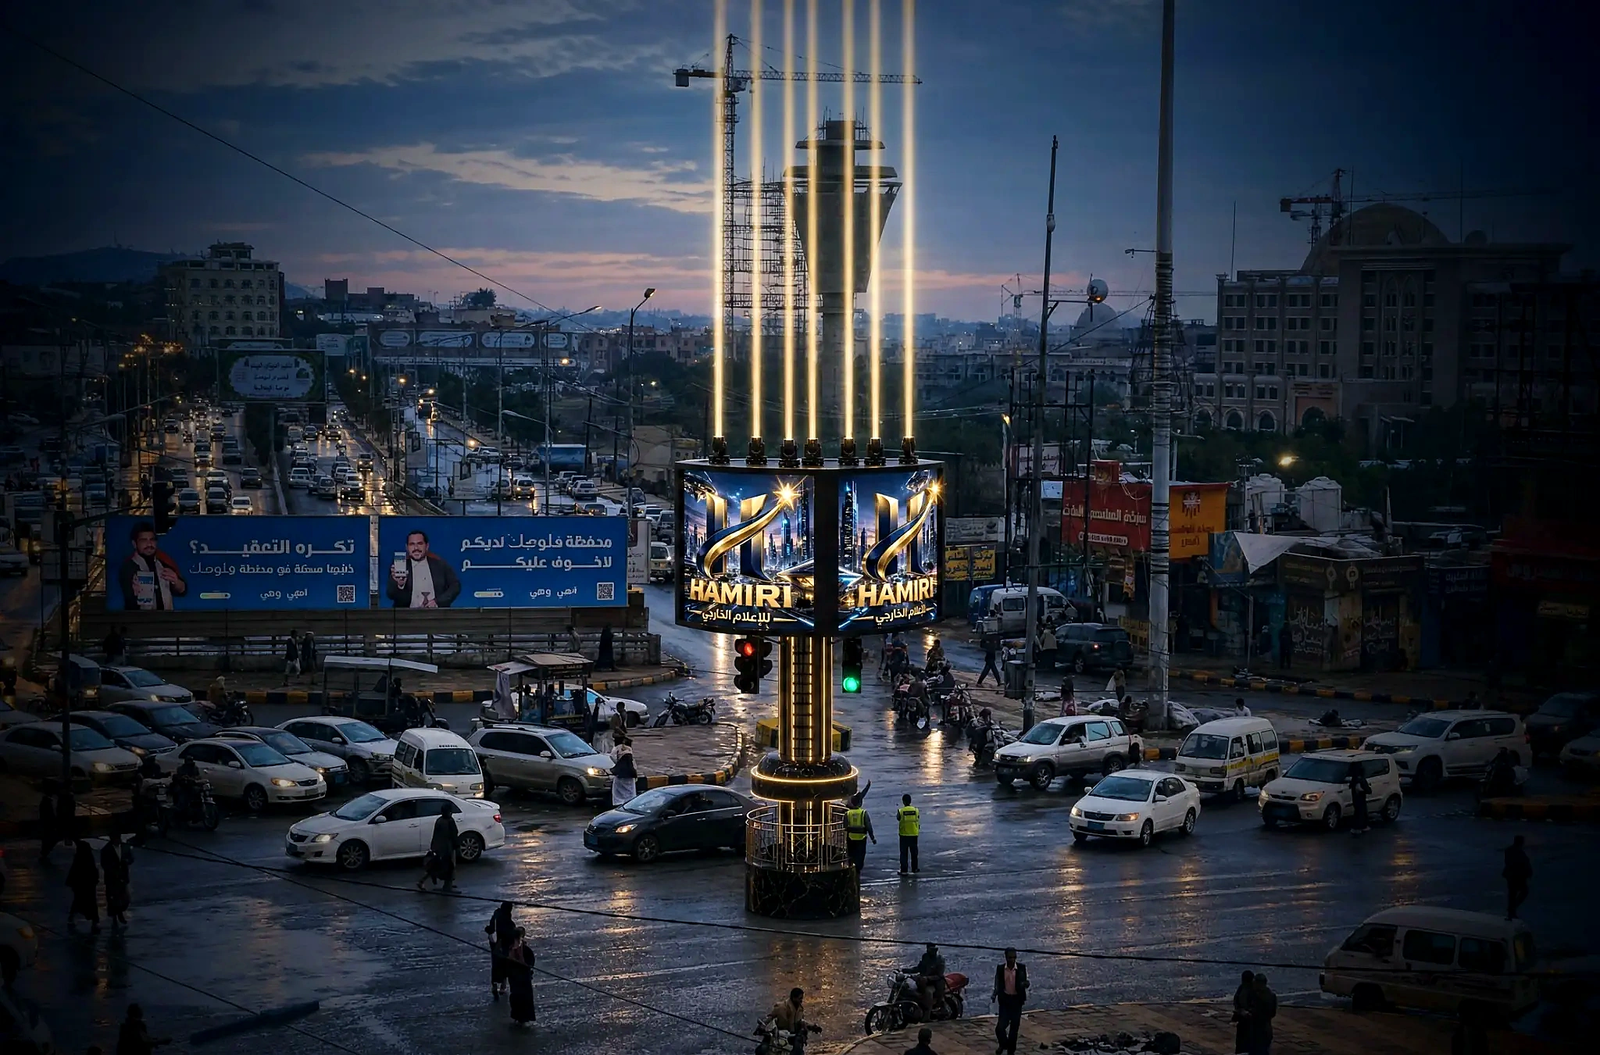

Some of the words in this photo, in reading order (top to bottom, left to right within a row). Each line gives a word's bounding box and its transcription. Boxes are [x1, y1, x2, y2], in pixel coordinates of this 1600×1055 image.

[189, 539, 290, 558] التعقيد؟
[295, 539, 355, 559] تكره
[461, 536, 504, 552] لديكم
[565, 535, 612, 550] محفظة
[277, 563, 291, 577] في
[461, 556, 548, 572] عليكم
[690, 578, 792, 609] HAMIRI
[857, 577, 935, 608] HAMIRI
[702, 609, 731, 623] الخارجي
[732, 611, 771, 628] للإعلام
[876, 607, 908, 625] الخارجي
